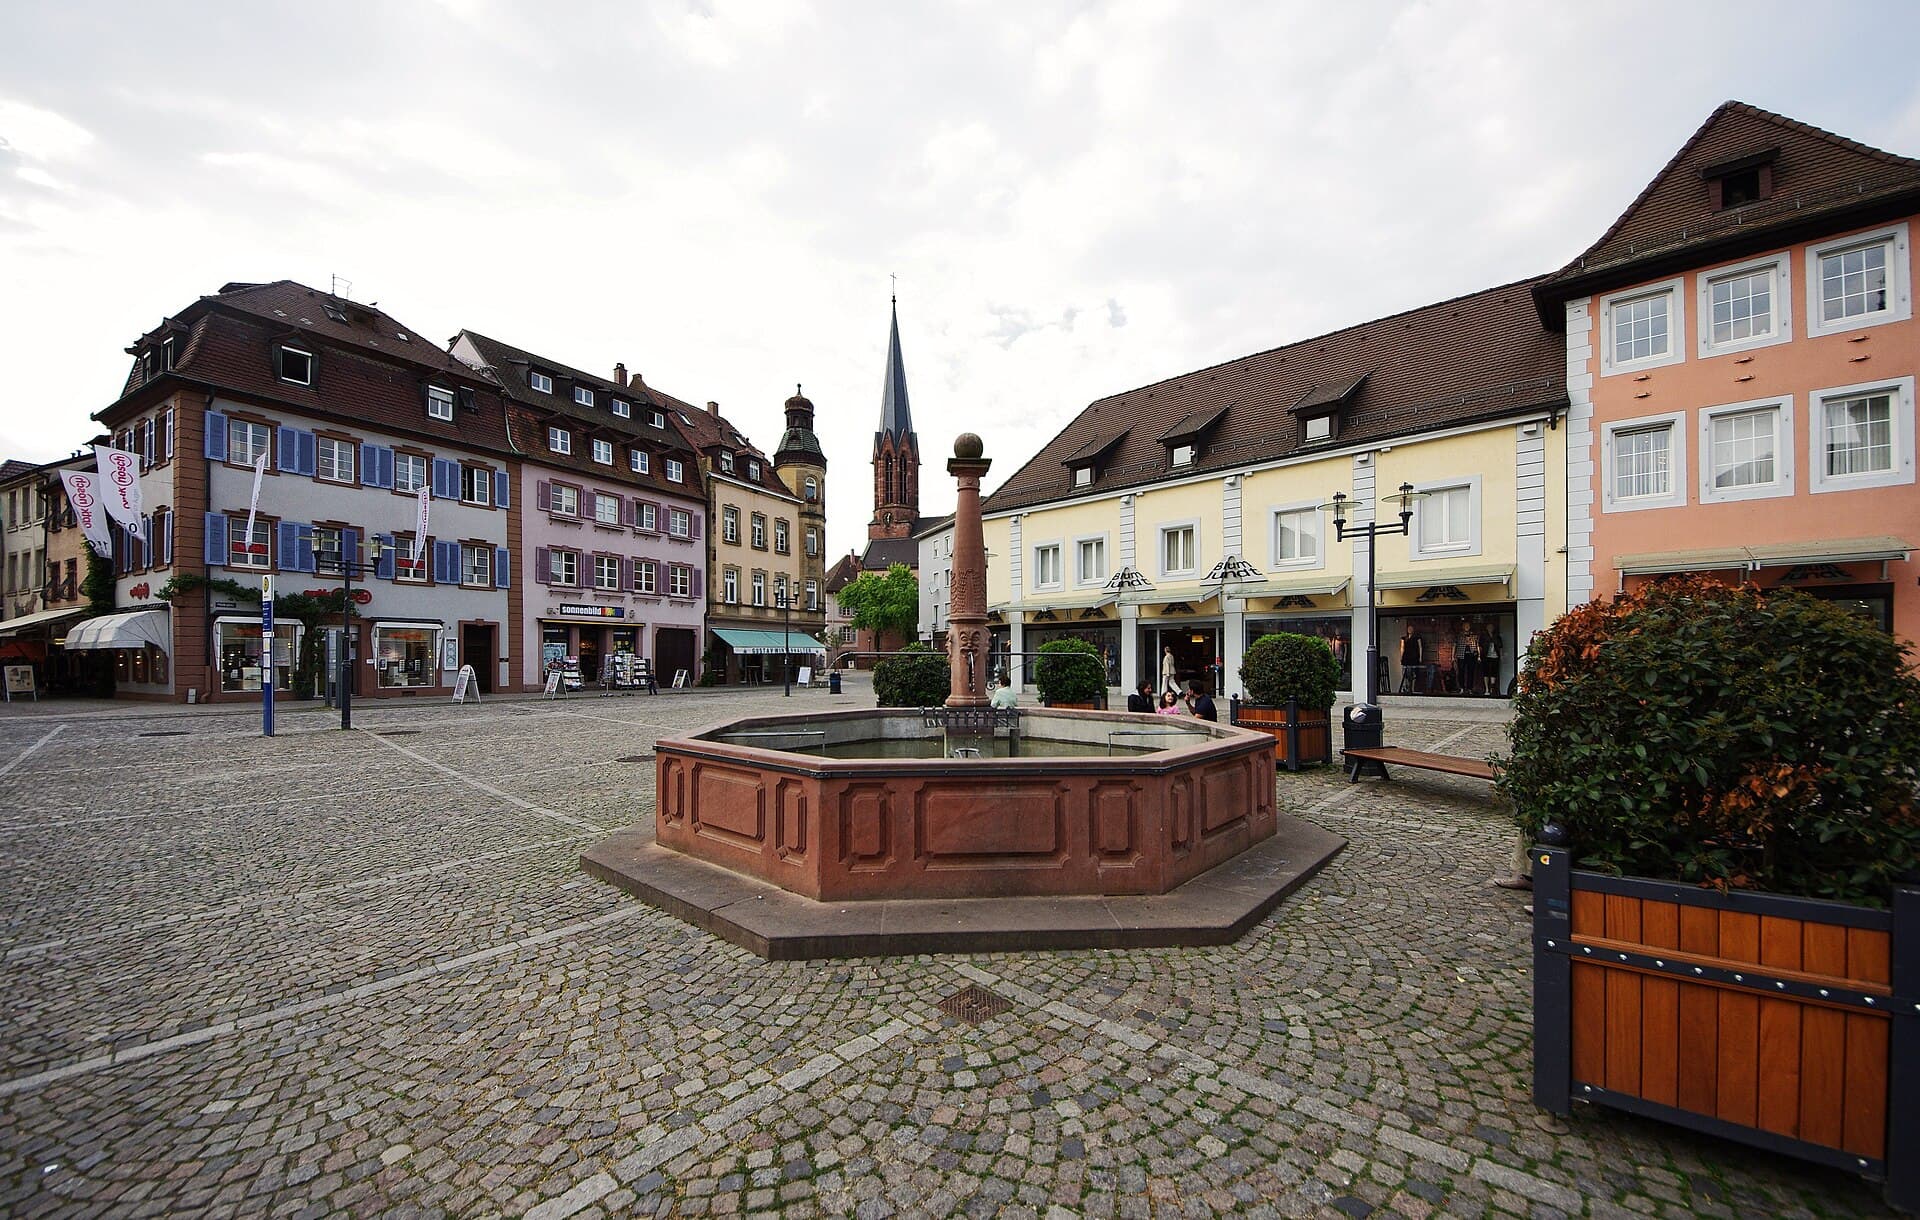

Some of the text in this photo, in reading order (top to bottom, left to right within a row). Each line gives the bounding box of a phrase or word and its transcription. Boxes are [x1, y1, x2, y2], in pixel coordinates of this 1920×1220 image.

[114, 456, 127, 483] nosch
[1213, 560, 1252, 571] Blum
[1112, 571, 1144, 581] Blum
[1201, 567, 1262, 580] Jundt
[1103, 578, 1152, 589] Jundt
